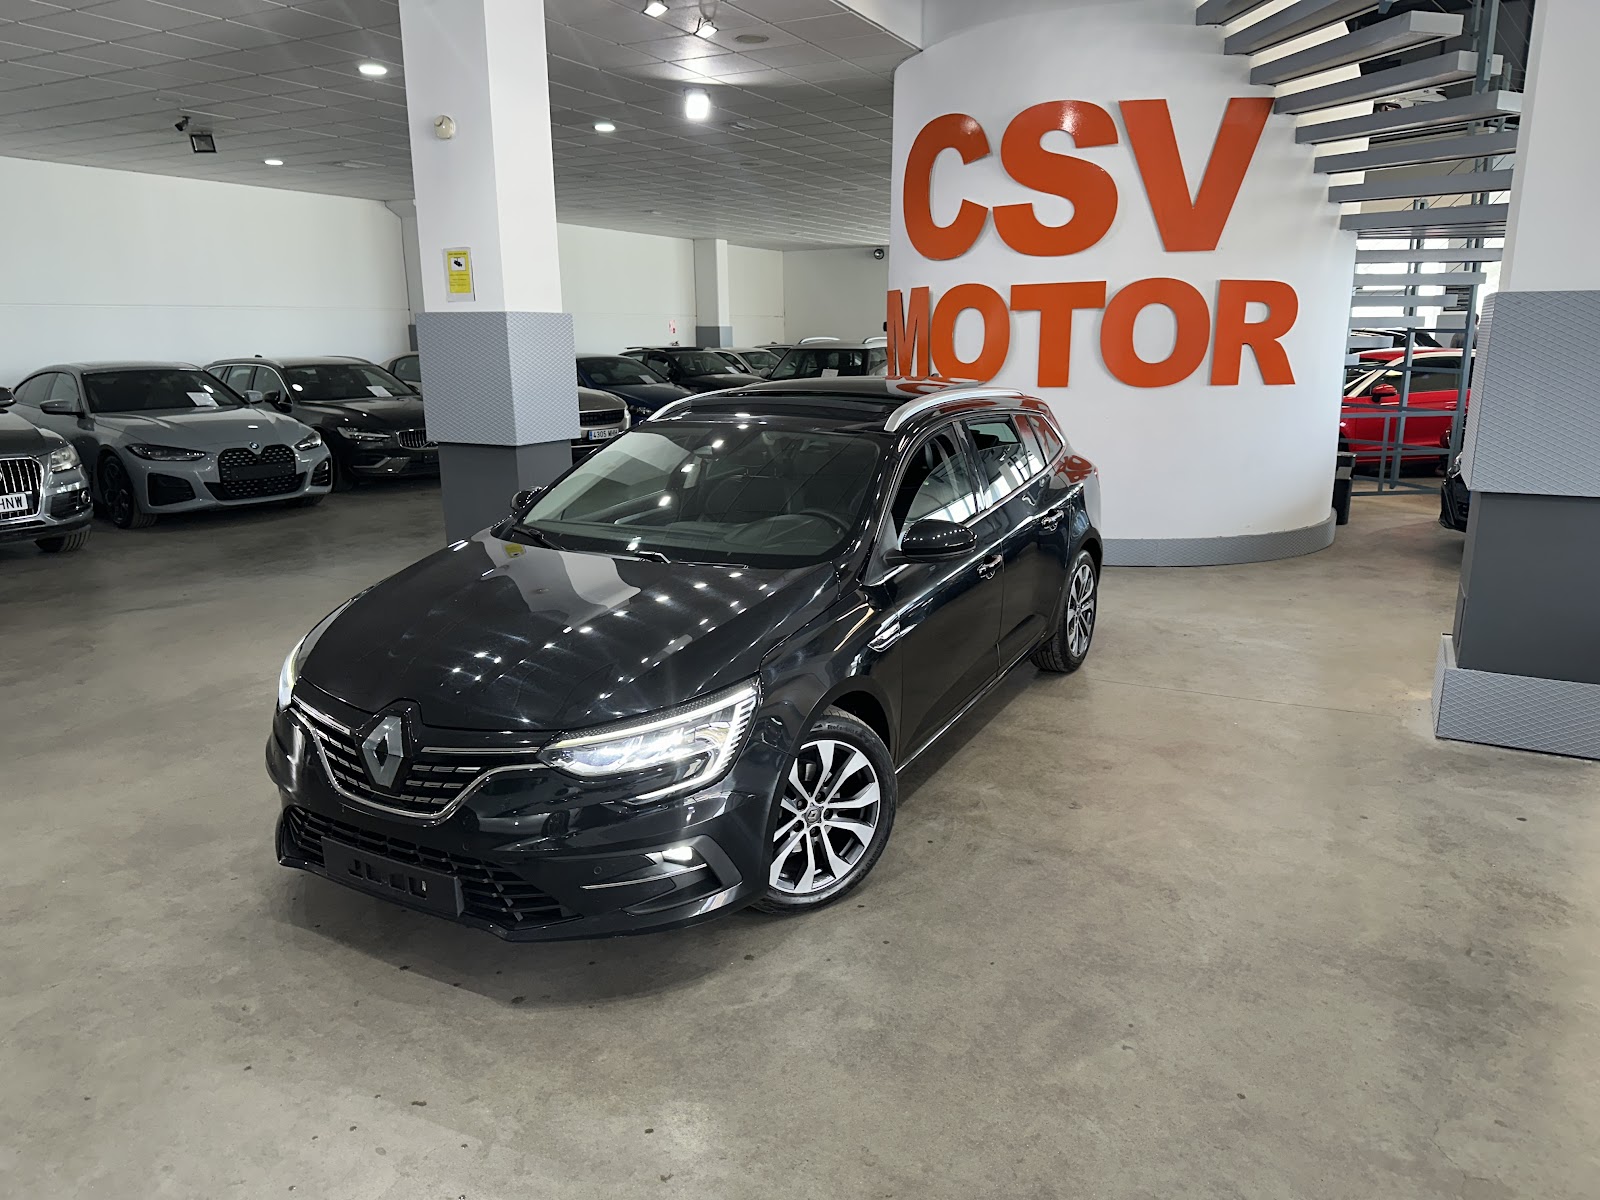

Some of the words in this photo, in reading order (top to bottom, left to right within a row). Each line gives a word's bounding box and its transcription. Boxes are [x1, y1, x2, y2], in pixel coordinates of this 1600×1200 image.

[903, 97, 1276, 261] CSV
[887, 277, 1299, 388] MOTOR
[593, 430, 607, 438] 4305
